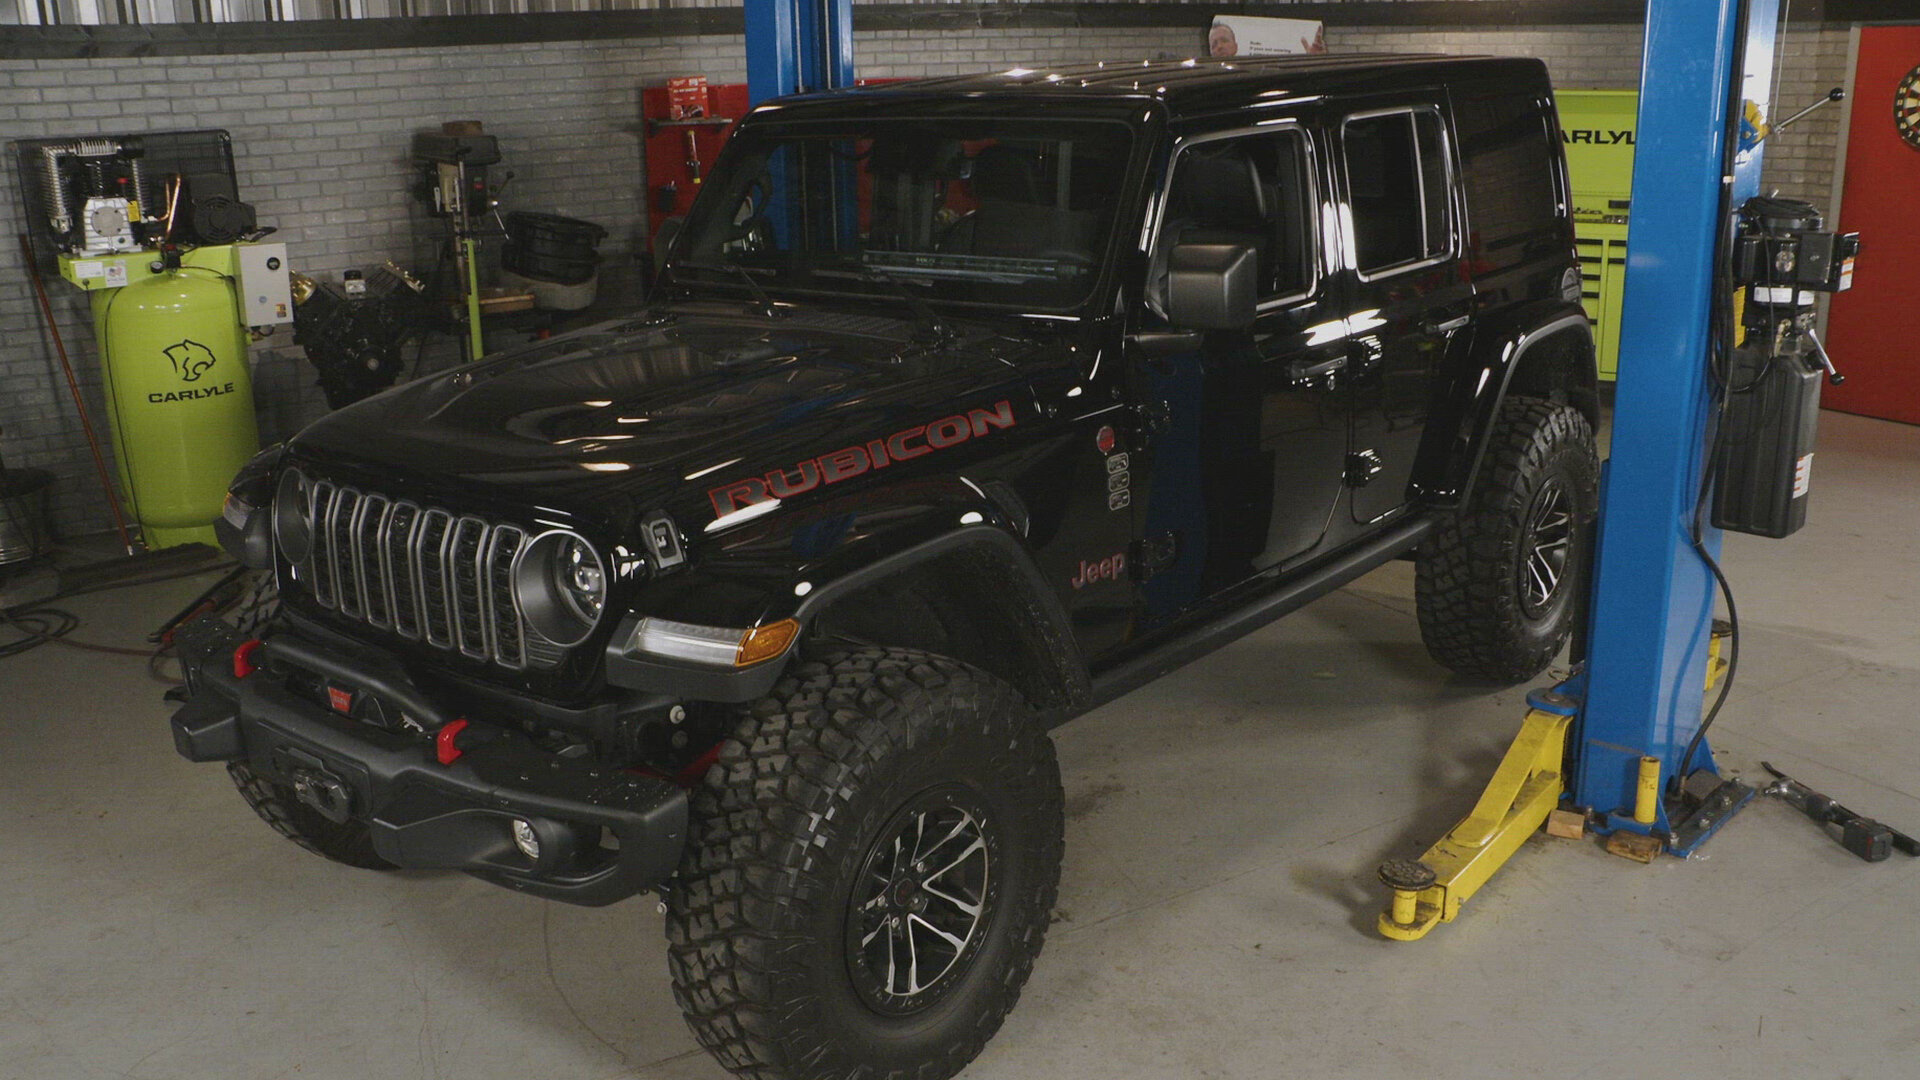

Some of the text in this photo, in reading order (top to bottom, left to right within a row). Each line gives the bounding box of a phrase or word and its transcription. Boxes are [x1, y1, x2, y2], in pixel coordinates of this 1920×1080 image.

[148, 382, 235, 403] CARLYLE
[707, 399, 1017, 518] RUBICON
[1071, 552, 1126, 589] Jeep
